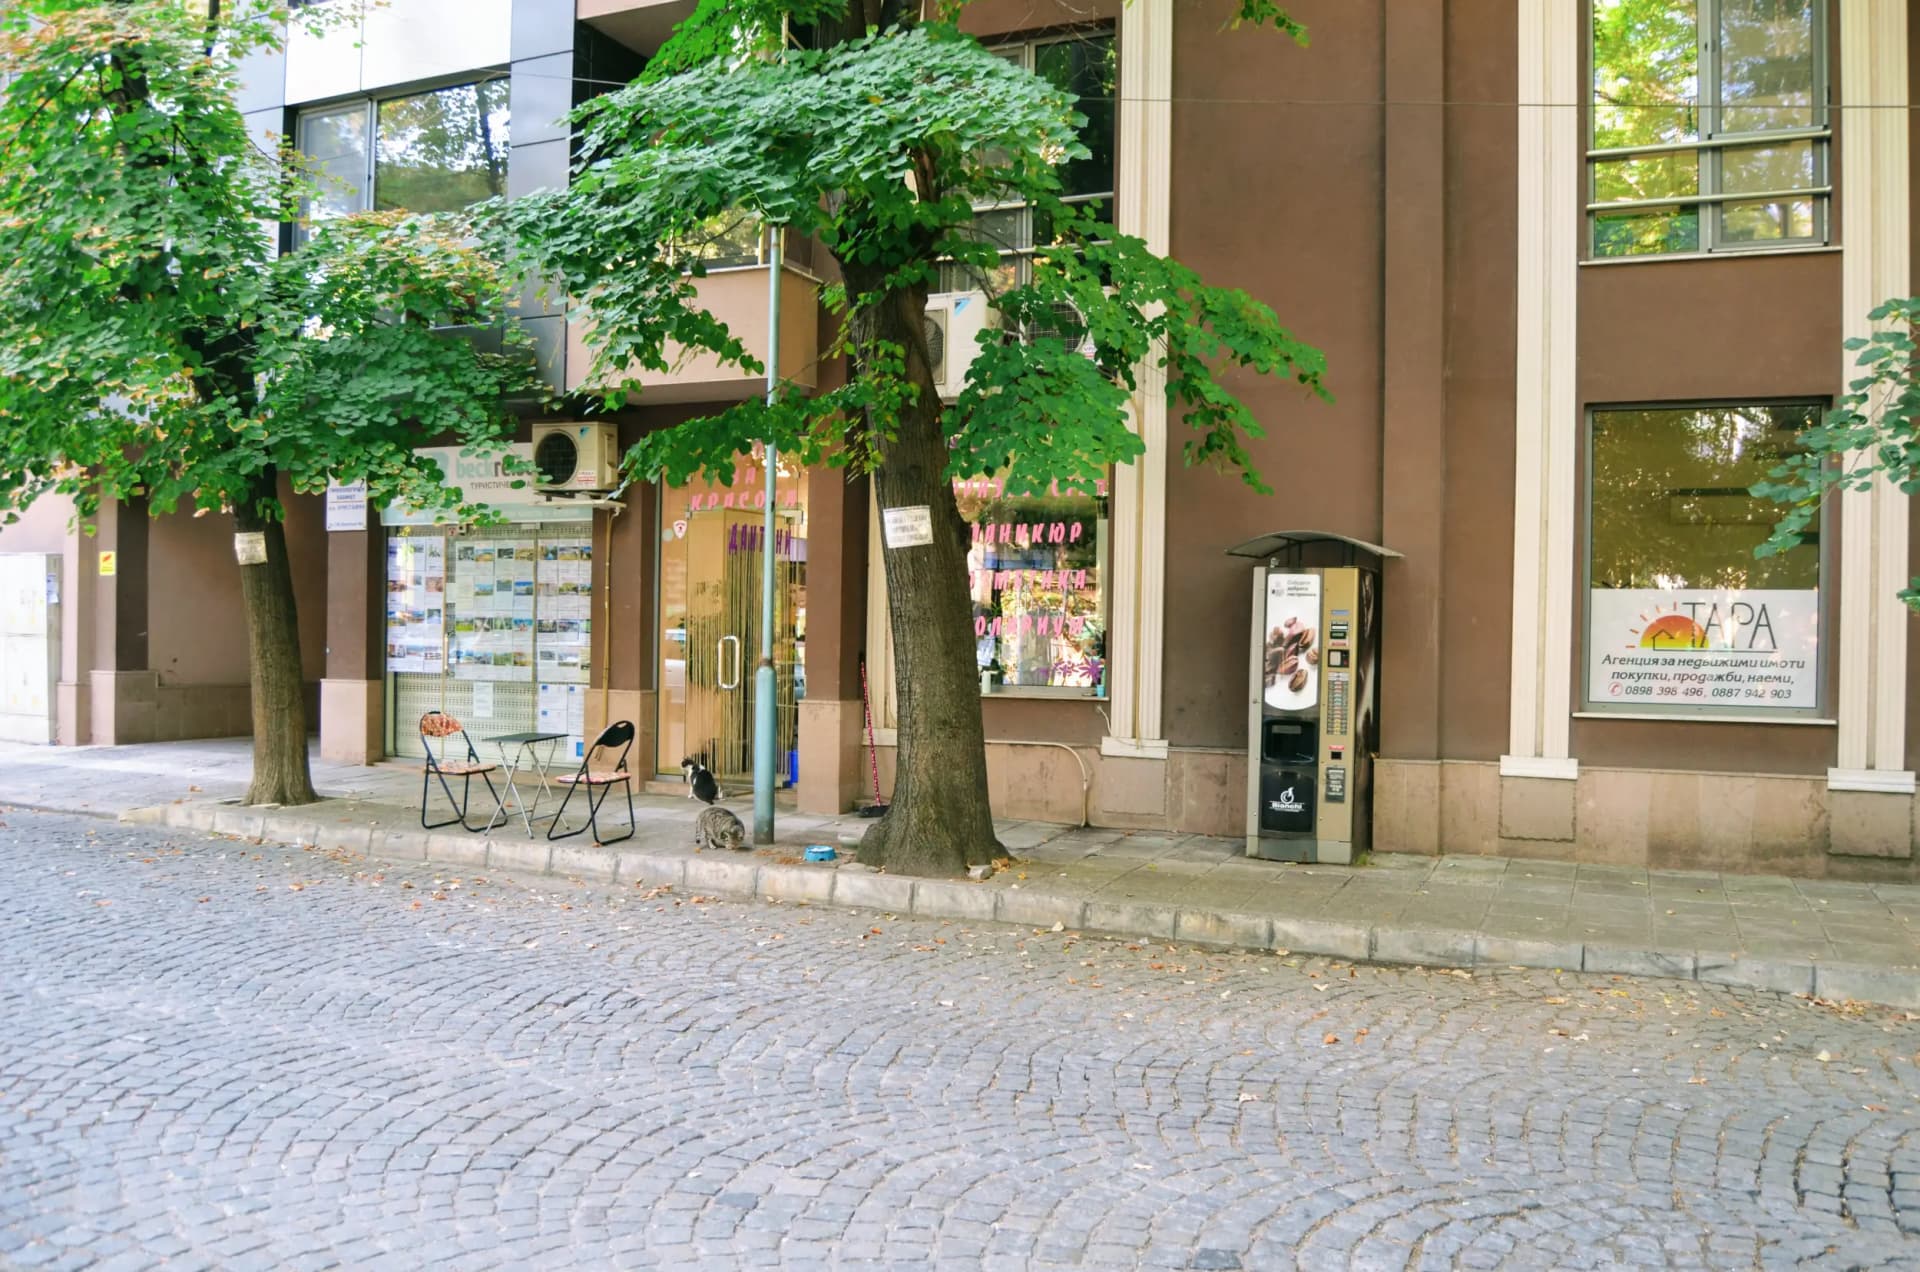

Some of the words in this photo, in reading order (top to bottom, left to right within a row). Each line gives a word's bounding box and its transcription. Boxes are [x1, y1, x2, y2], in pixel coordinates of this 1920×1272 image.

[1601, 654, 1659, 667] Агенция
[1660, 658, 1675, 666] за
[1677, 659, 1758, 670] недвижими
[1759, 660, 1806, 669] имоти
[1611, 671, 1671, 682] покупки,
[1672, 671, 1745, 685] продажби,
[1747, 676, 1795, 685] наеми,
[1625, 686, 1653, 696] 0898
[1711, 688, 1740, 698] 0887
[1744, 688, 1766, 698] 942
[1770, 689, 1792, 699] 903
